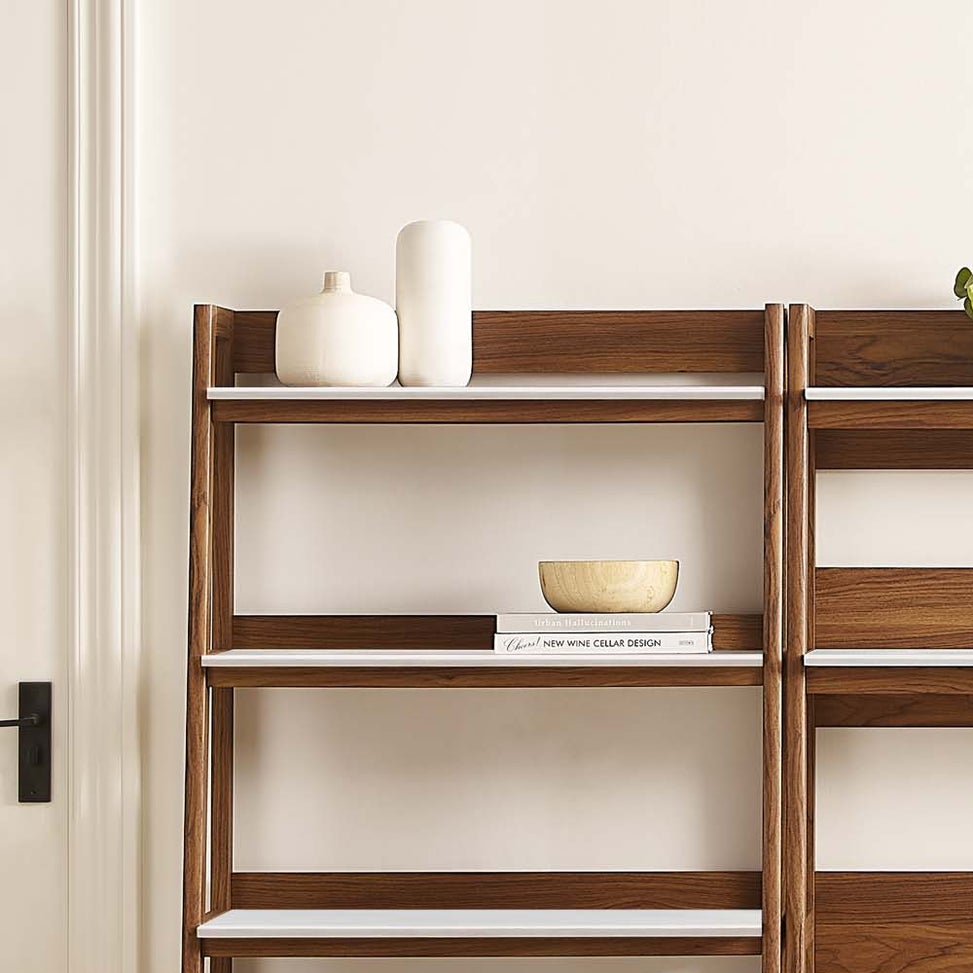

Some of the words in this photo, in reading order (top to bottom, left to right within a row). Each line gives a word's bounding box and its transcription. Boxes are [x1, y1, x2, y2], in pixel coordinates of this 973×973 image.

[543, 638, 566, 648] NEW
[567, 638, 591, 648] WINE
[592, 638, 626, 648] CELLAR
[627, 638, 662, 648] DESIGN
